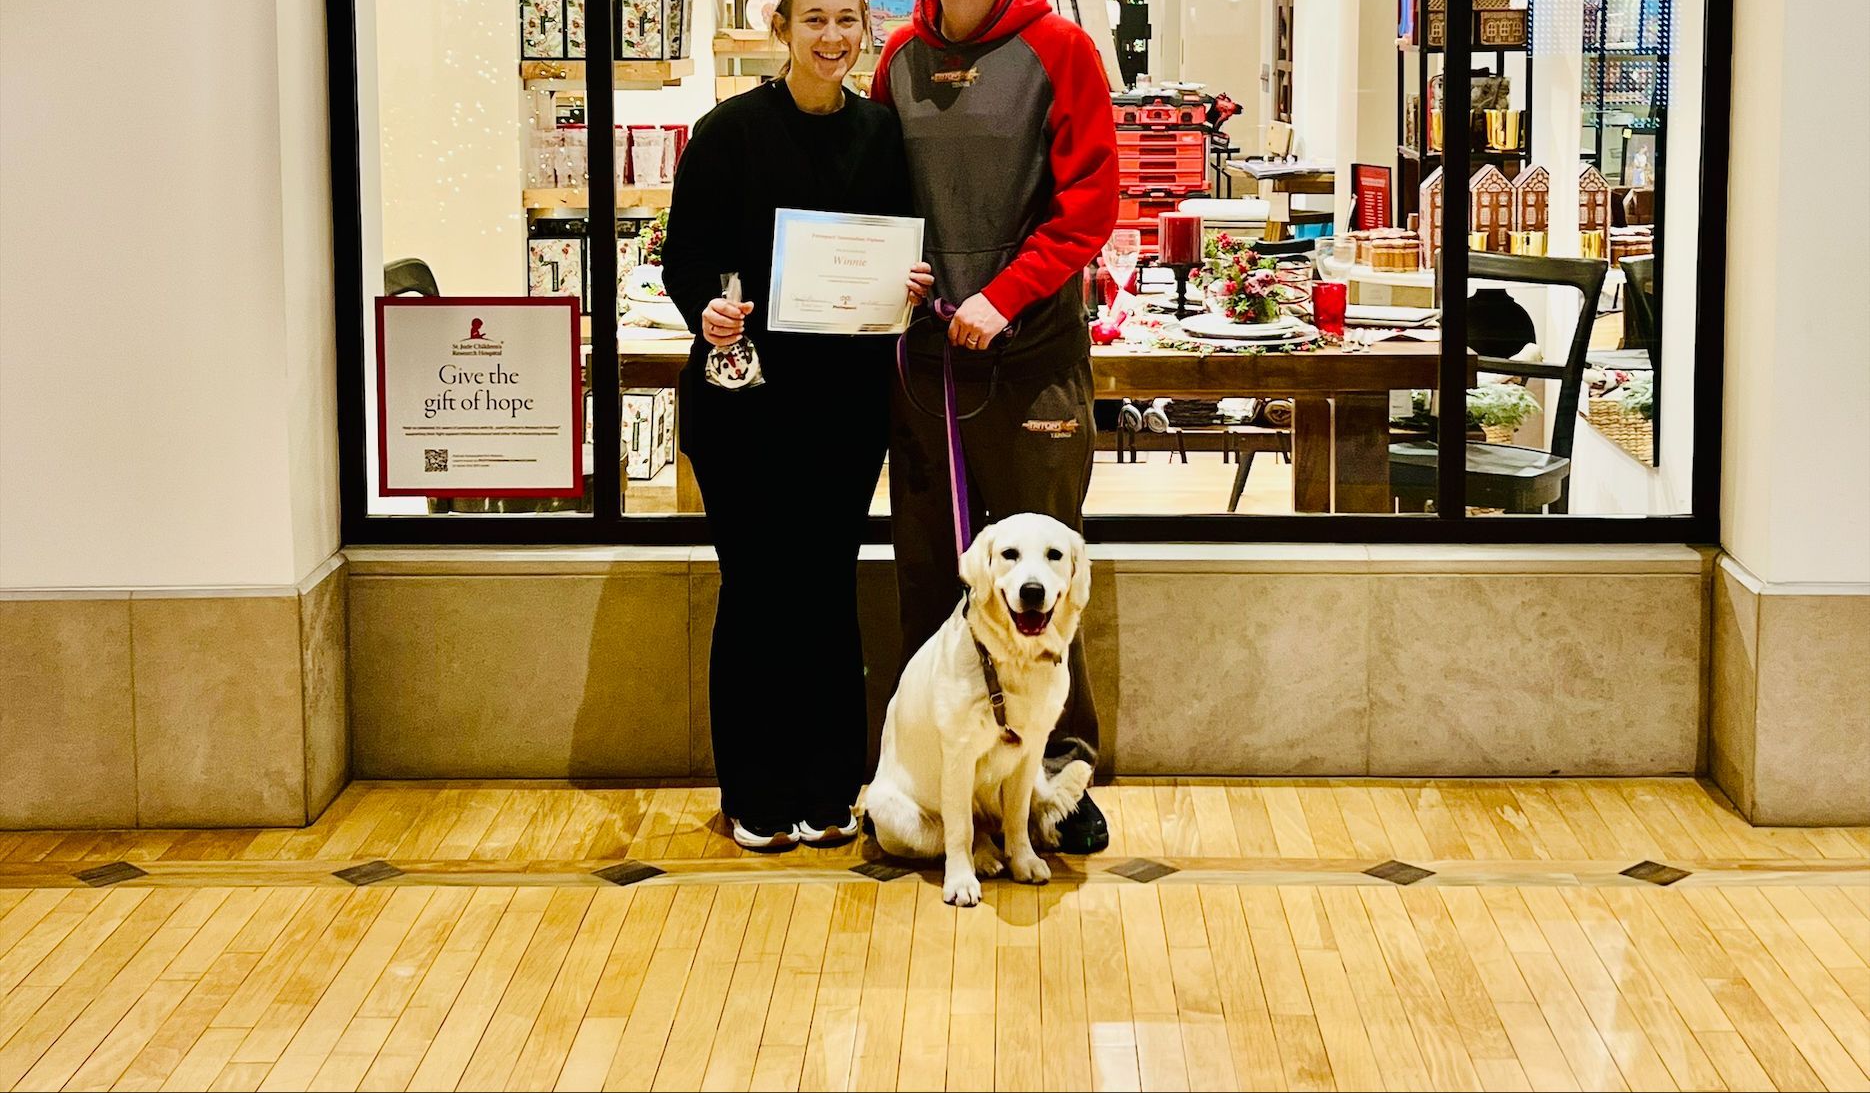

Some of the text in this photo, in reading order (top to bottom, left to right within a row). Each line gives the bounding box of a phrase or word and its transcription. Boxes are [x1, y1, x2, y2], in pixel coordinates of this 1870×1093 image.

[438, 363, 520, 385] Give the
[424, 389, 534, 419] gift of hope
